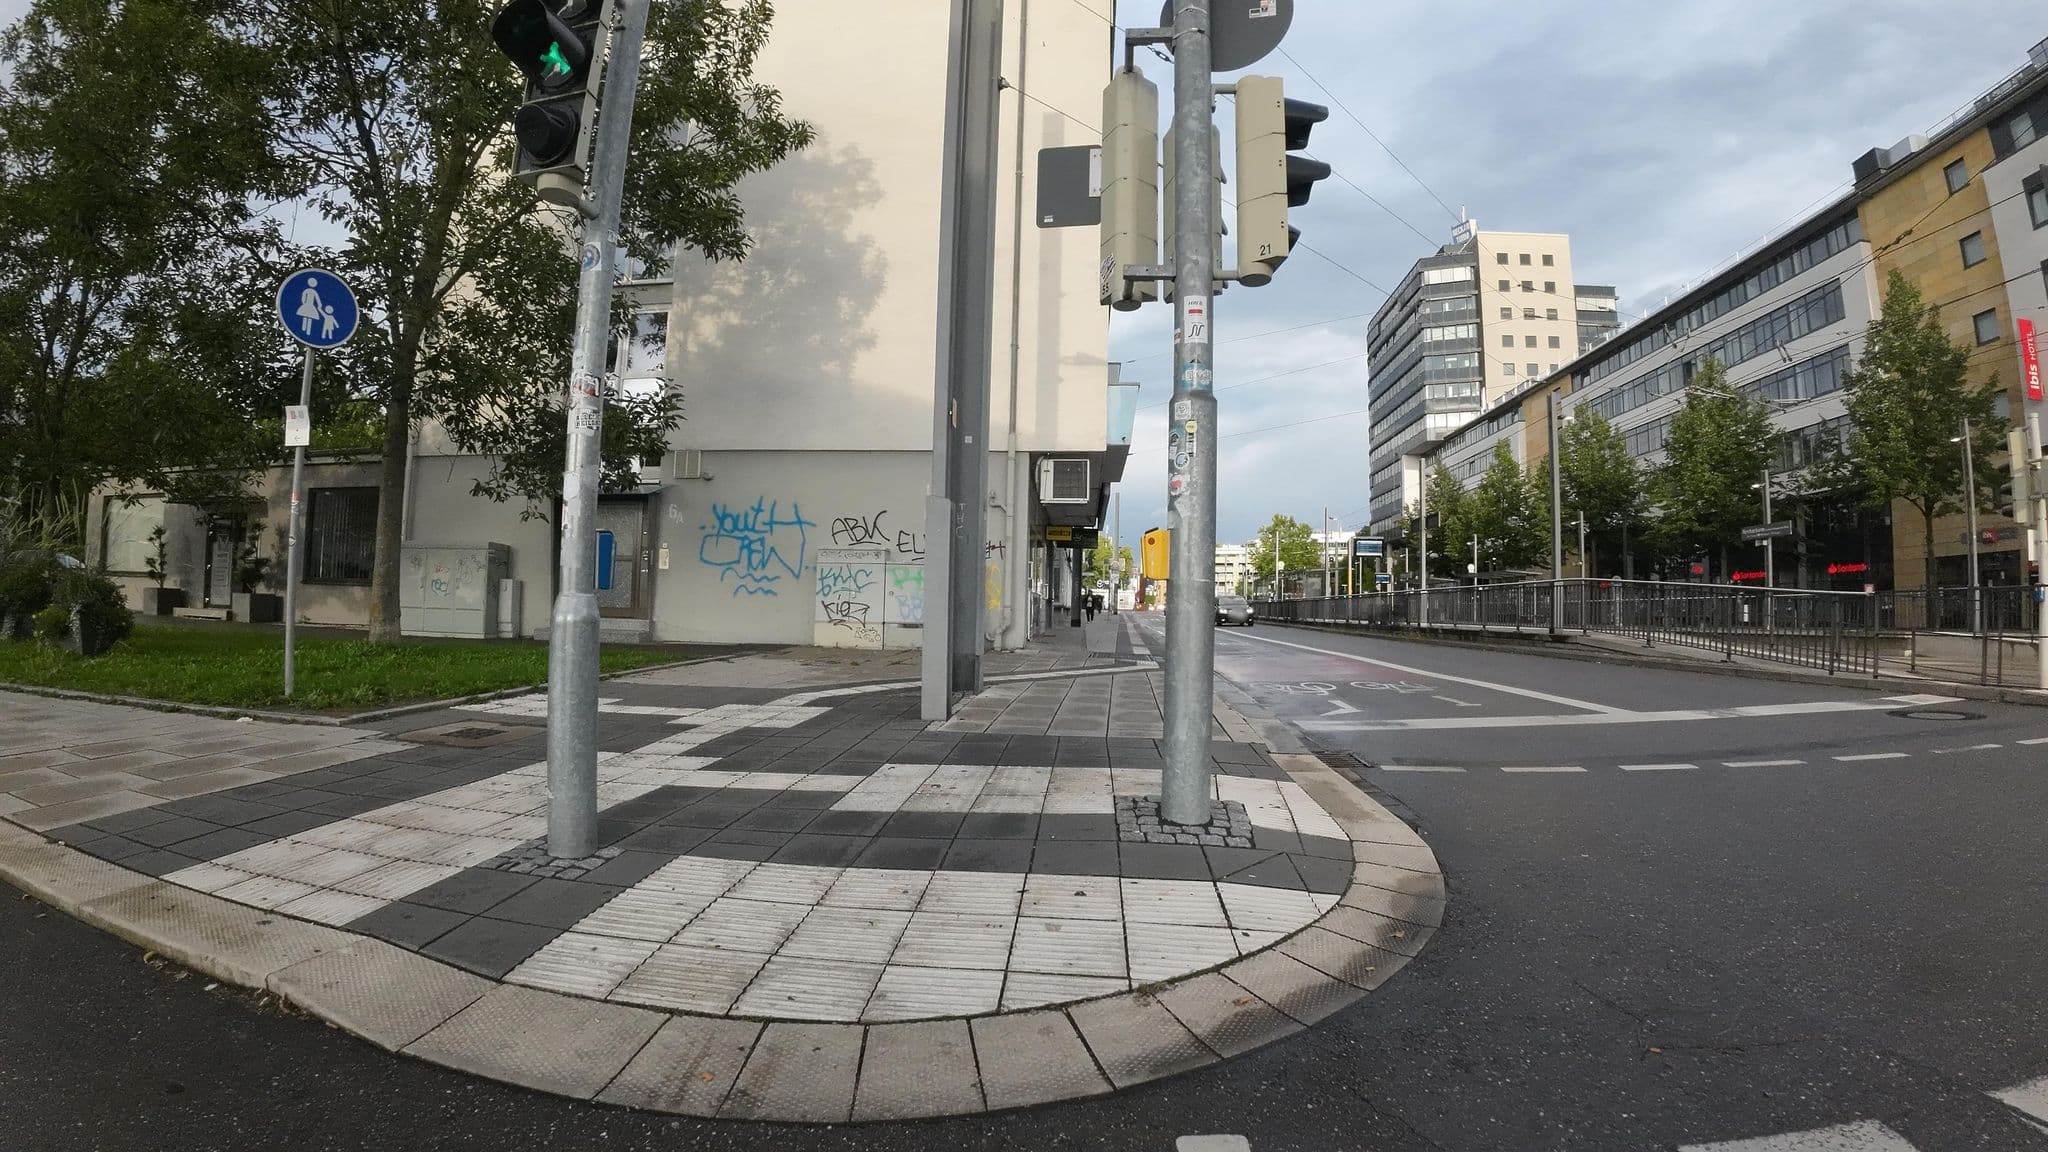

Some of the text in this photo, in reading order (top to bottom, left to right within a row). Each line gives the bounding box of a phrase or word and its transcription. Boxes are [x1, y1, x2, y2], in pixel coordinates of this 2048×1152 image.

[1260, 244, 1271, 256] 21
[2026, 331, 2040, 390] ibis HOTEL
